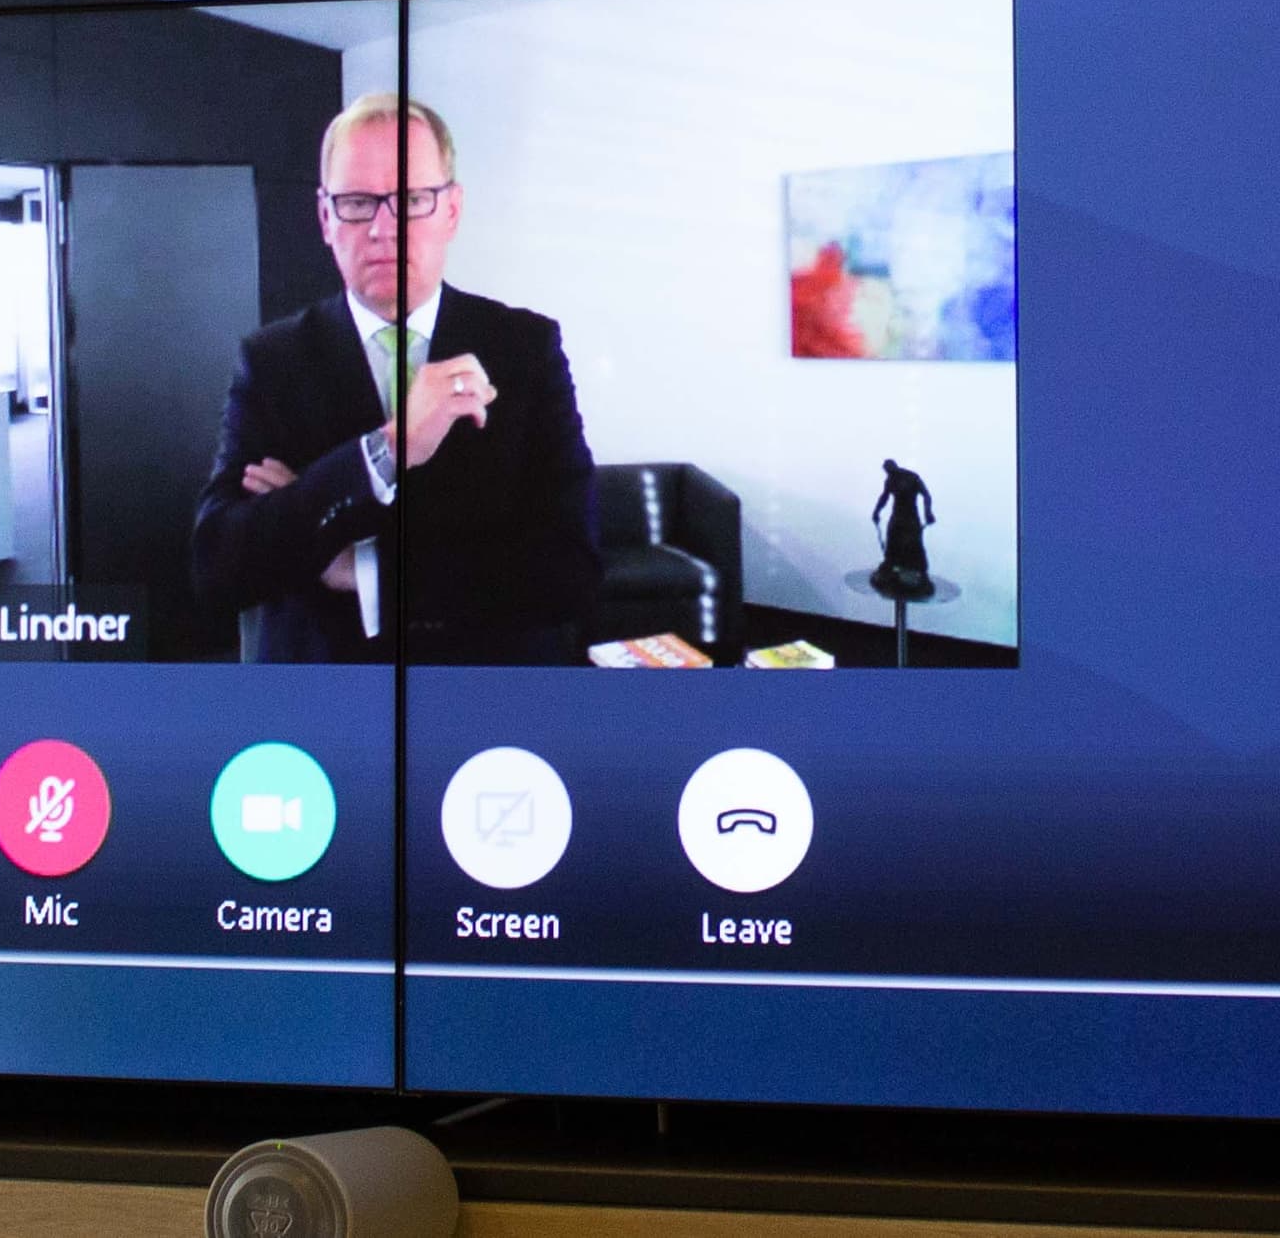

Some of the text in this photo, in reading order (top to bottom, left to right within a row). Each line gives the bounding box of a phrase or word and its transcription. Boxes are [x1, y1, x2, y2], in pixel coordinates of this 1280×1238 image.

[0, 603, 131, 642] Lindner
[24, 896, 79, 927] Mic
[217, 900, 333, 934] Camera
[456, 906, 561, 940] Screen
[701, 913, 794, 947] Leave
